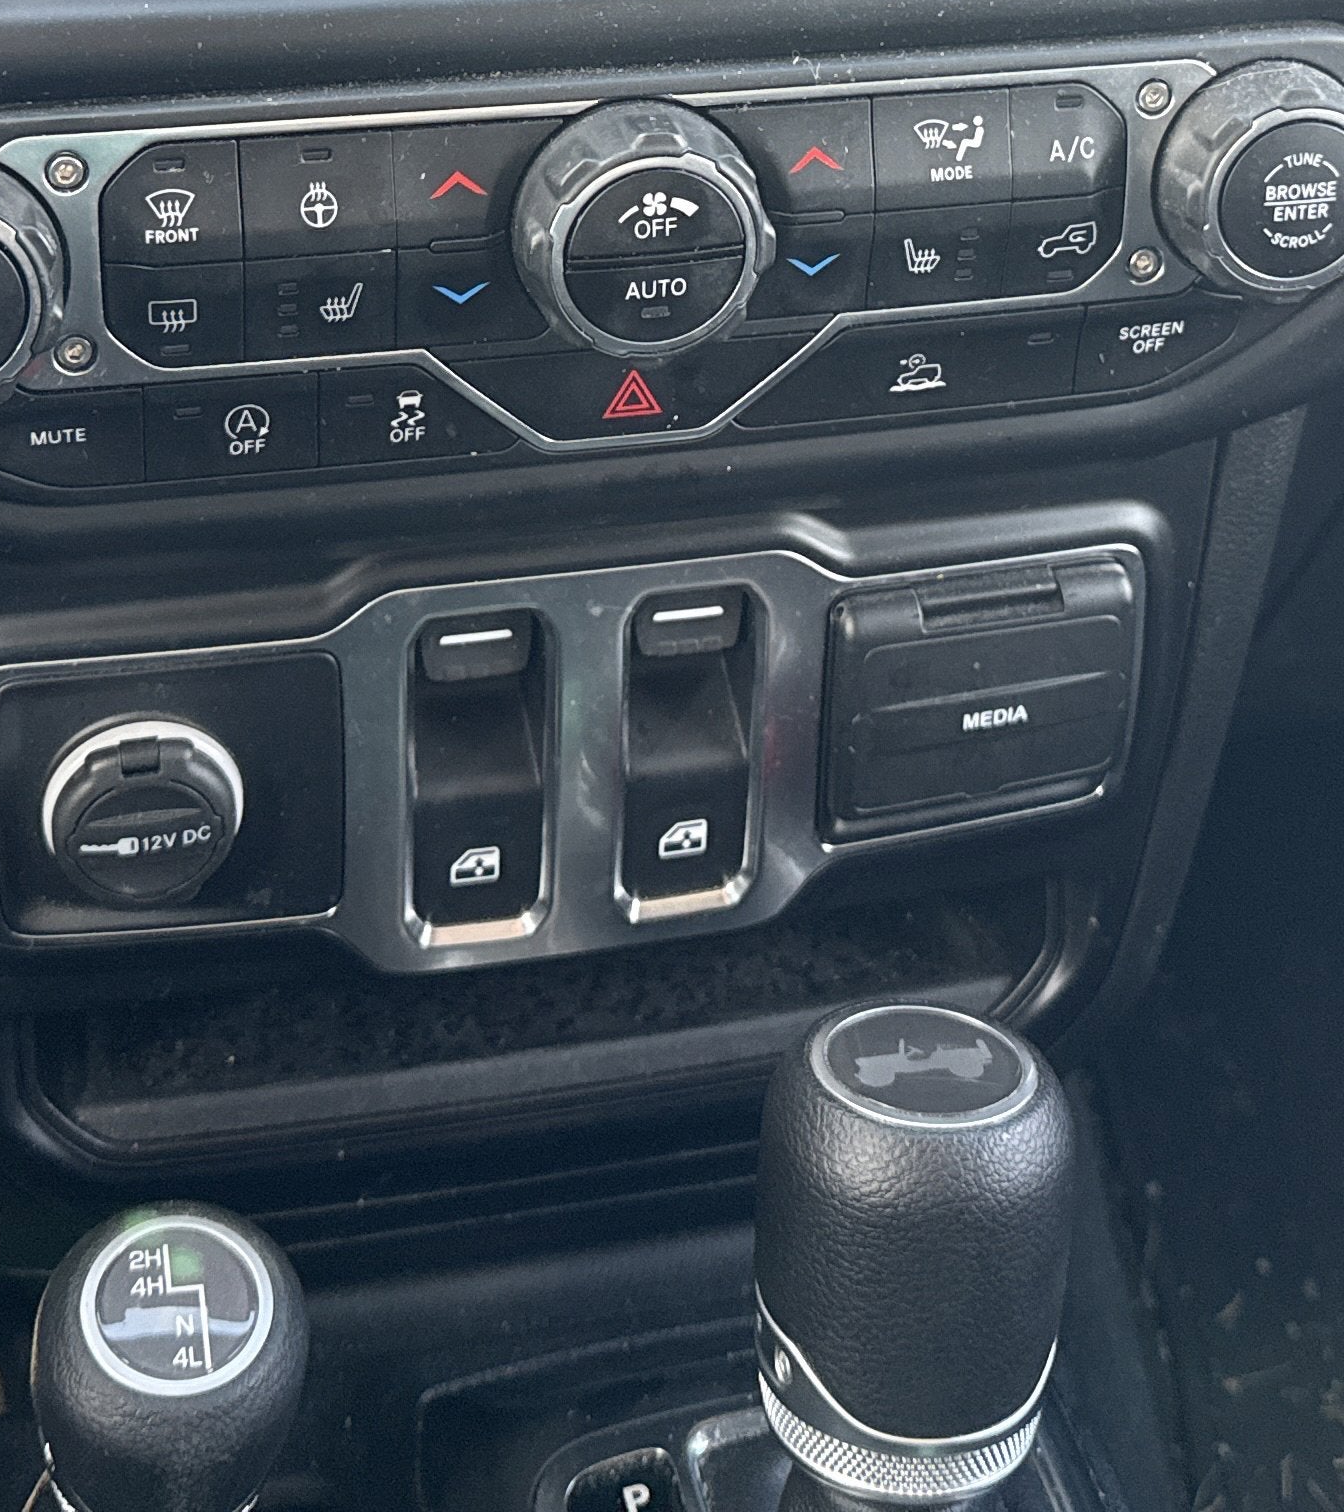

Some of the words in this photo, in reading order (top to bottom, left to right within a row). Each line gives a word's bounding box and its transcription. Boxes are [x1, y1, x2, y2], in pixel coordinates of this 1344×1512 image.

[1050, 136, 1094, 162] A/C
[1284, 152, 1323, 168] TUNE
[930, 165, 973, 182] MODE
[1265, 181, 1337, 201] BROWSE
[1273, 203, 1329, 222] ENTER
[145, 228, 199, 244] FRONT
[634, 217, 677, 239] OFF
[1271, 230, 1326, 248] SCROLL
[625, 278, 687, 300] AUTO
[1119, 320, 1184, 340] SCREEN
[1132, 337, 1166, 354] OFF
[30, 428, 87, 446] MUTE
[390, 426, 425, 443] OFF
[230, 439, 266, 455] OFF
[963, 705, 1028, 731] MEDIA
[142, 832, 177, 851] 12V
[182, 825, 211, 845] DC
[129, 1248, 162, 1270] 2H
[130, 1275, 164, 1297] 4H
[175, 1314, 195, 1337] N
[172, 1346, 203, 1368] 4L
[622, 1483, 651, 1512] P
